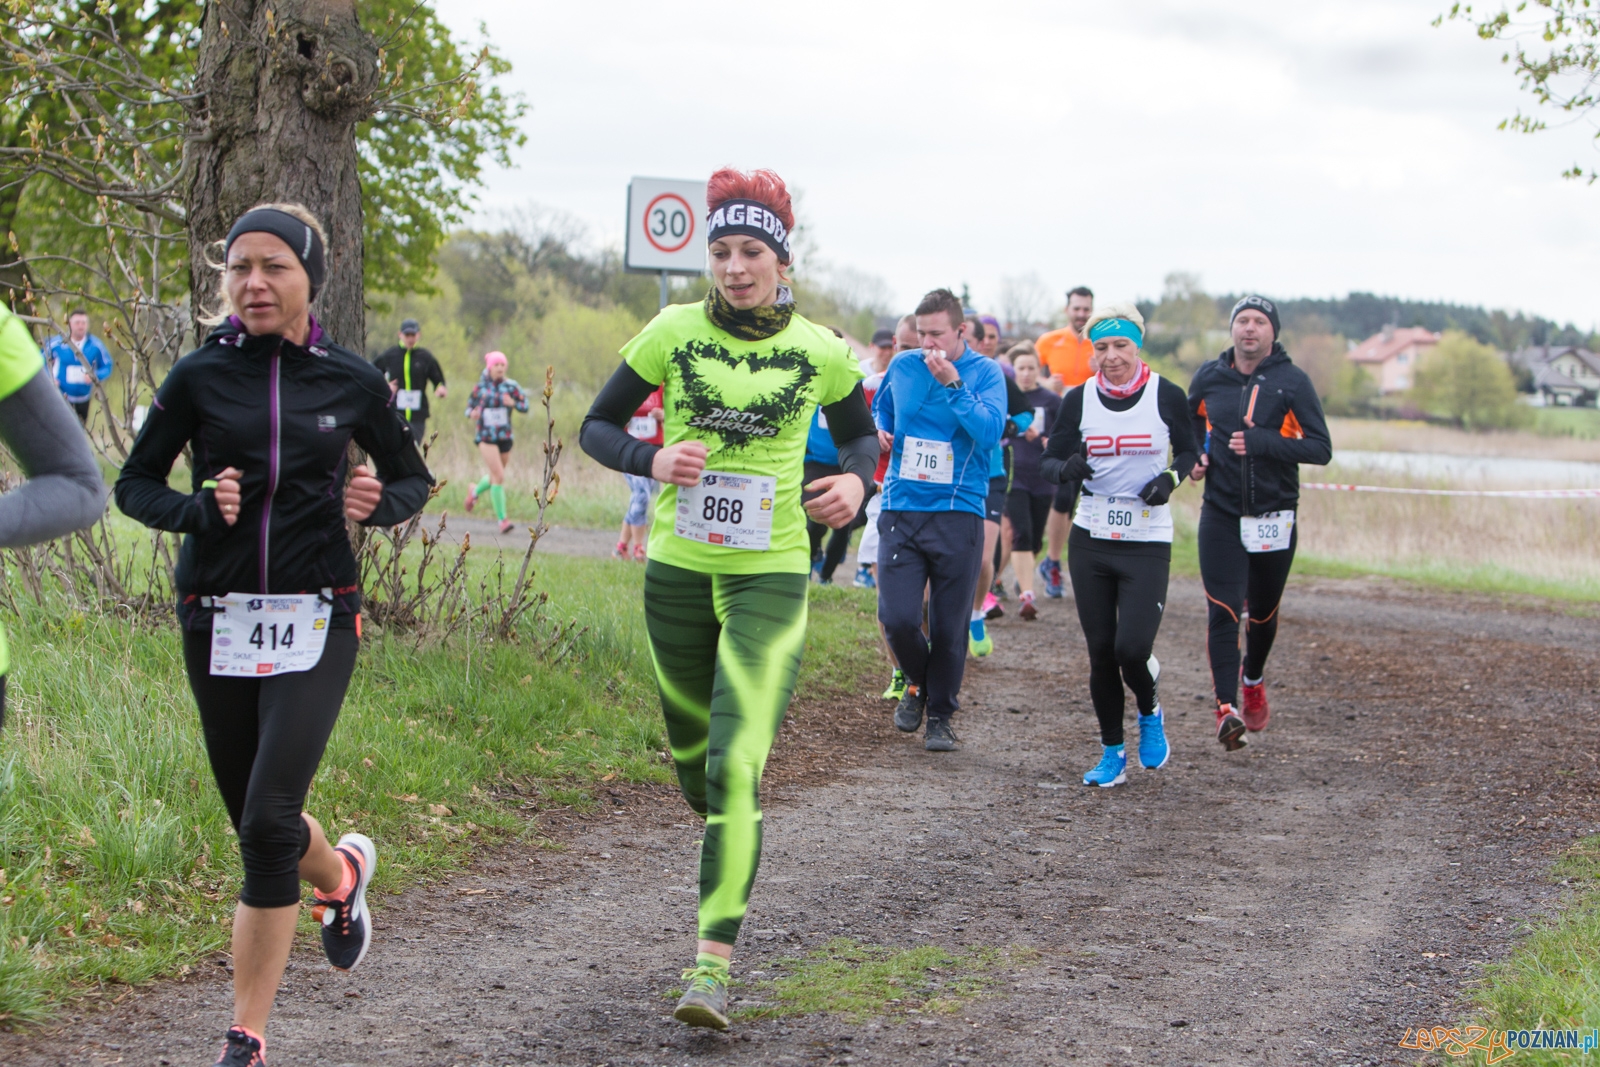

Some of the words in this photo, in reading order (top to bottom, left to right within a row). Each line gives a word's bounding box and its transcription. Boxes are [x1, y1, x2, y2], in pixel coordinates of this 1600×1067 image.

[652, 208, 686, 238] 30
[707, 407, 763, 423] DIRTY
[689, 417, 778, 436] SPARROWS
[916, 453, 937, 469] 716
[703, 495, 743, 524] 868
[1108, 510, 1132, 526] 650
[1258, 524, 1279, 538] 528
[249, 622, 294, 650] 414
[232, 652, 250, 660] 5KM
